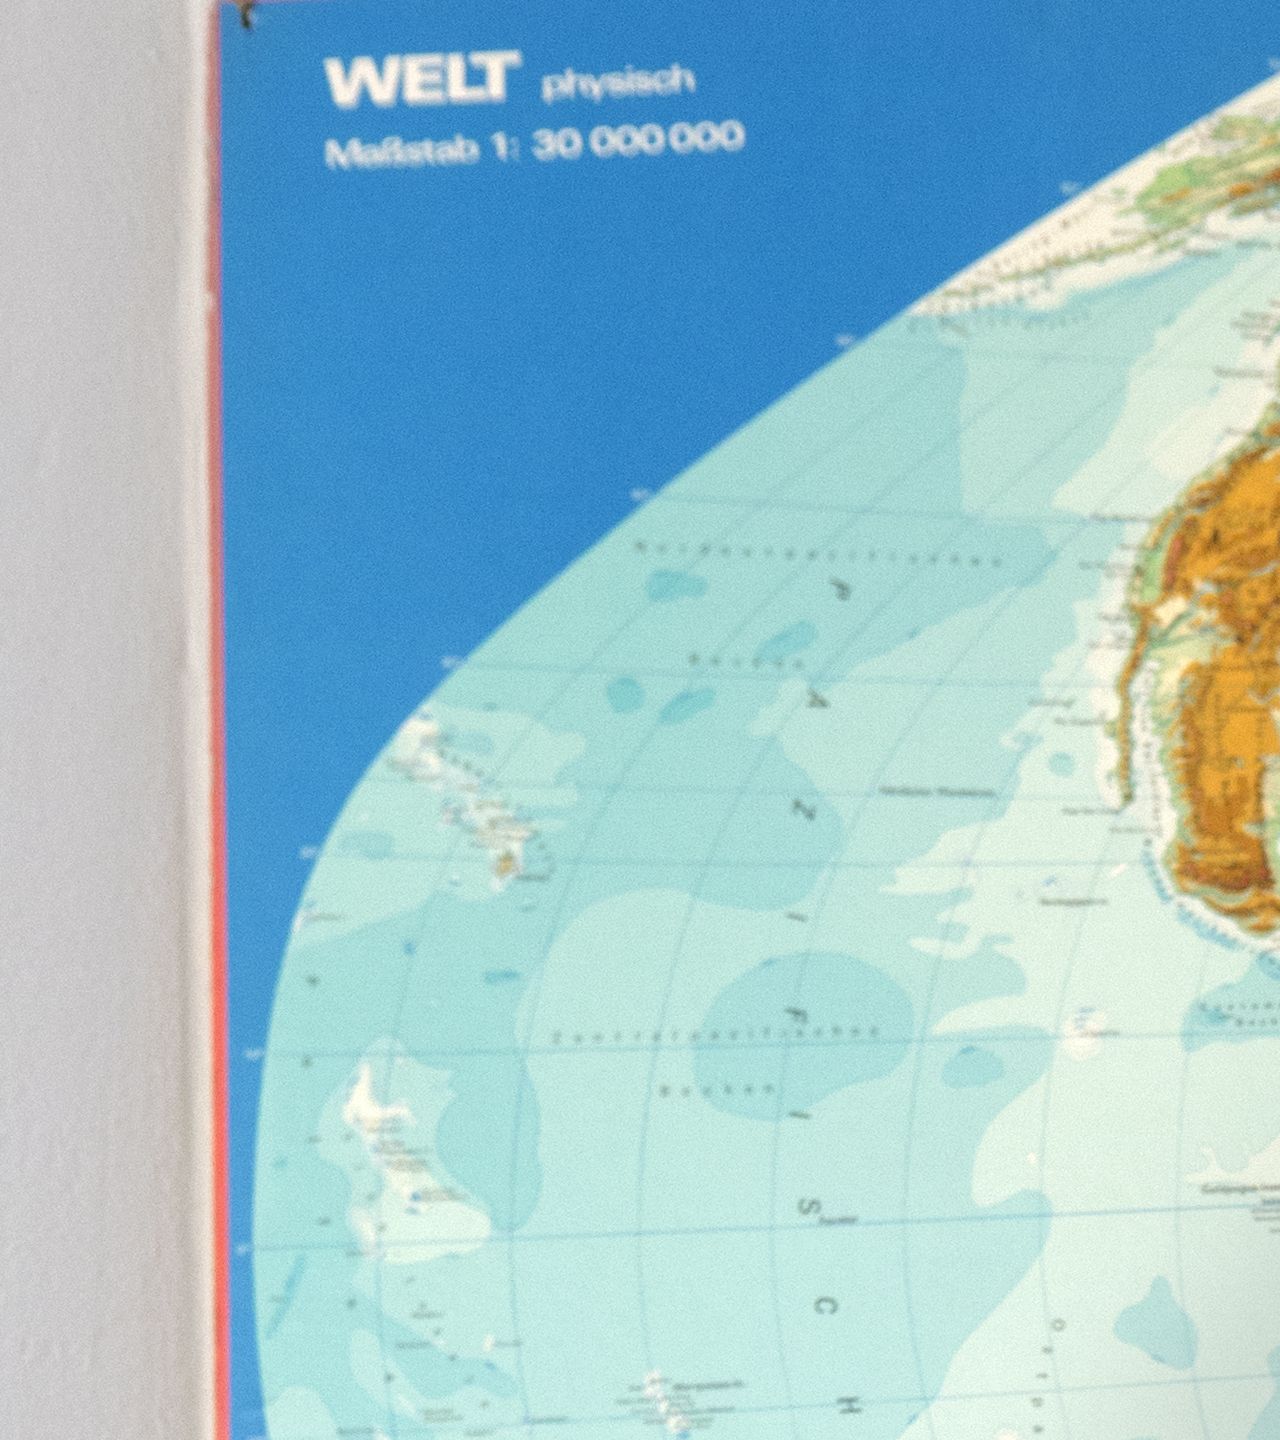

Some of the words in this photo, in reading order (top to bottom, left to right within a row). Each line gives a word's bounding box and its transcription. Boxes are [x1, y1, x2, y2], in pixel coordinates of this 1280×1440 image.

[324, 51, 521, 109] WELT
[541, 64, 697, 106] physisch
[324, 133, 480, 170] Maßstab
[533, 128, 583, 163] 30
[590, 124, 666, 159] 000
[669, 120, 746, 156] 000
